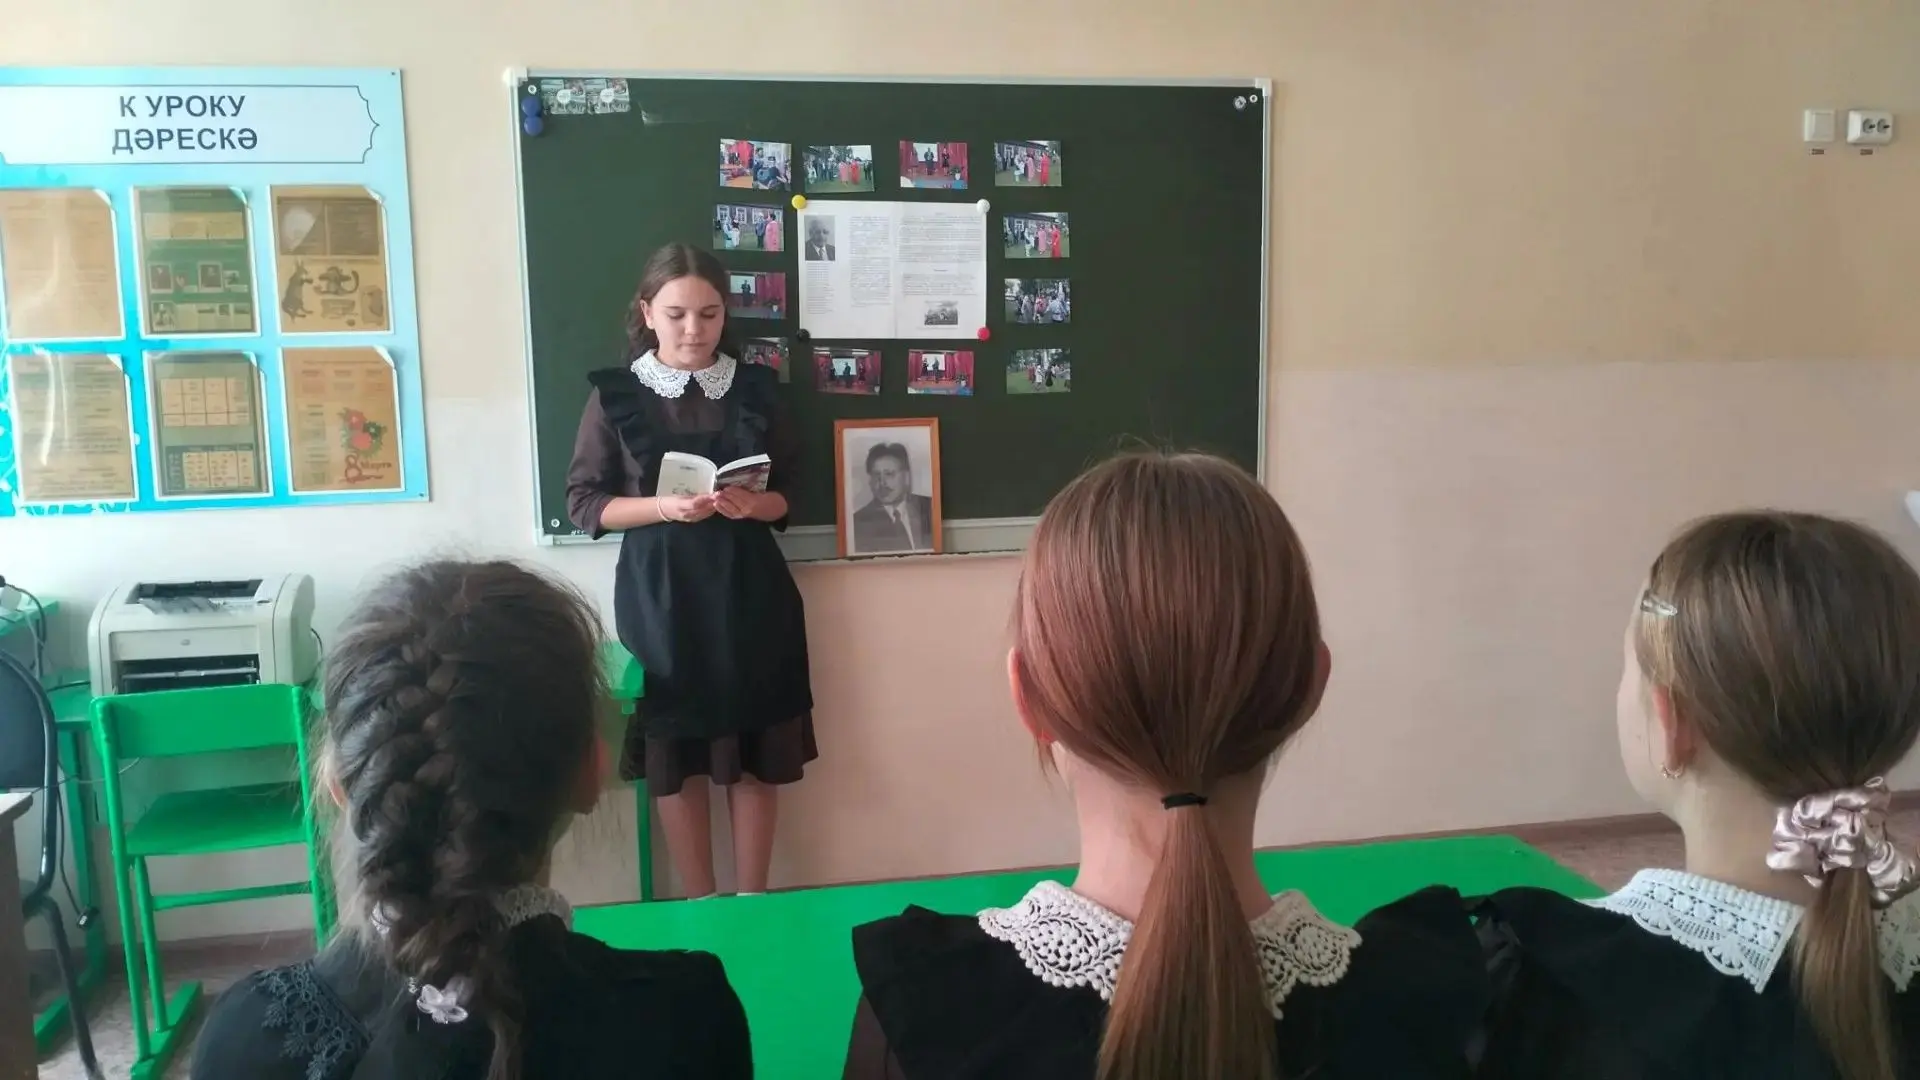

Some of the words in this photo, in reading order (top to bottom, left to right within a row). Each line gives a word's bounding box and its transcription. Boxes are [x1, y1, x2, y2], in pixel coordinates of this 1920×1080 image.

[120, 95, 136, 117] К
[145, 94, 246, 117] УРОКУ
[112, 127, 258, 154] ДӘРЕСКӘ
